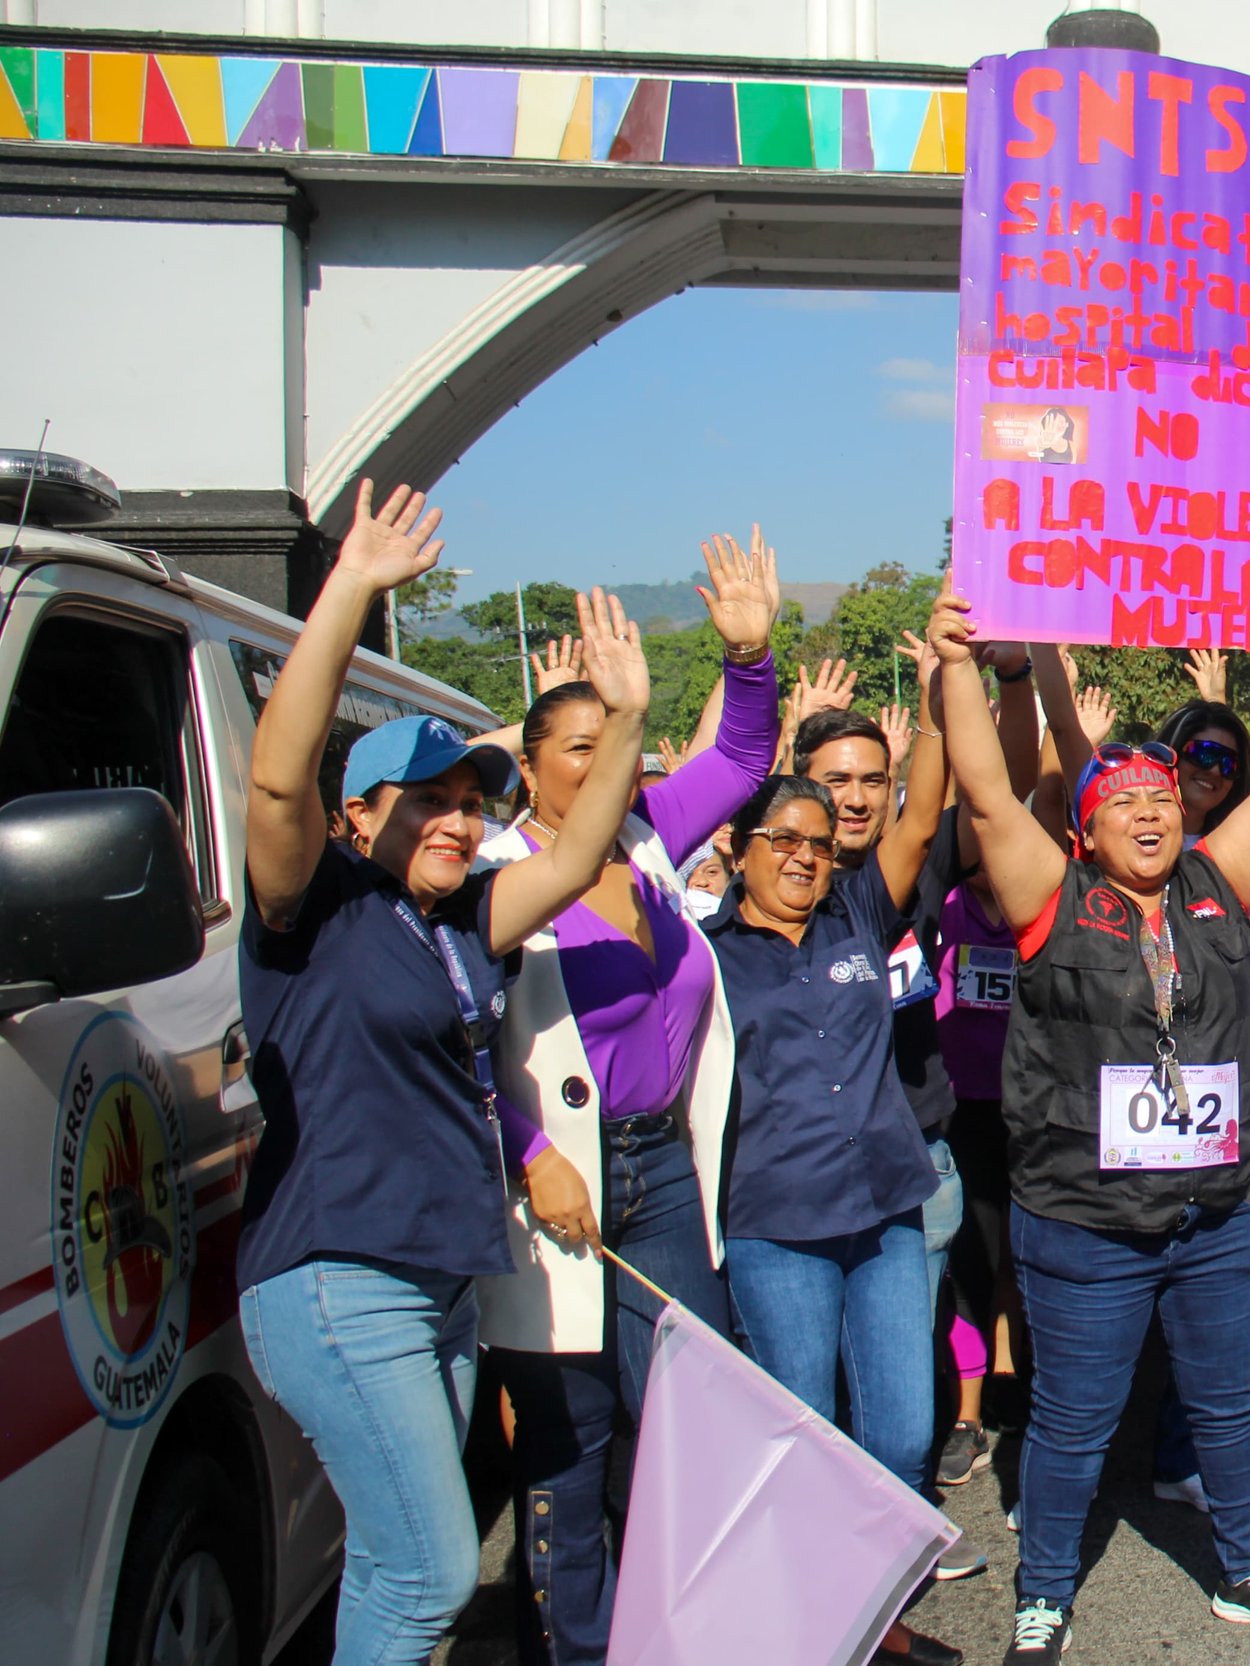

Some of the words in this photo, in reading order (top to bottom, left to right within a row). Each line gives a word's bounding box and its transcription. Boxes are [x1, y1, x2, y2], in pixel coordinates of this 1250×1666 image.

[995, 292, 1193, 353] hospital
[1135, 406, 1199, 461] NO
[983, 478, 1020, 531] A
[1041, 477, 1105, 531] LA
[1008, 536, 1205, 597] CONTRA
[975, 971, 1017, 1001] 15
[1128, 1092, 1222, 1135] 042
[61, 1062, 94, 1298] BOMBEROS
[136, 1038, 191, 1280] VOLUNTARIOS
[93, 1320, 181, 1411] GUATEMALA
